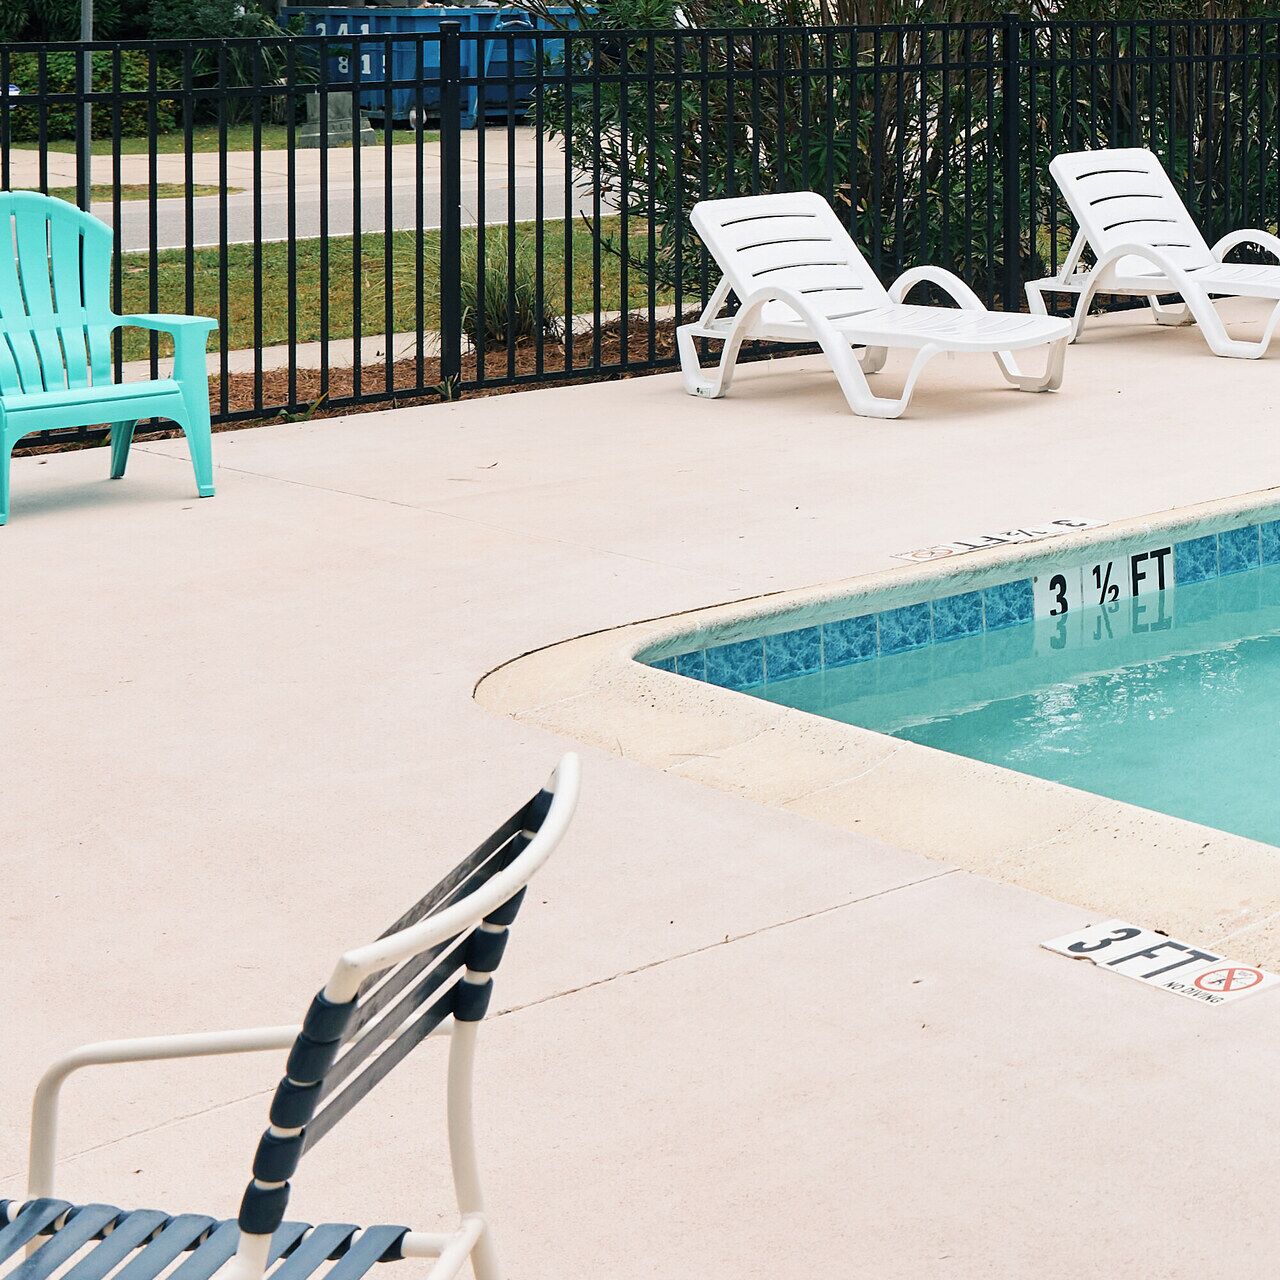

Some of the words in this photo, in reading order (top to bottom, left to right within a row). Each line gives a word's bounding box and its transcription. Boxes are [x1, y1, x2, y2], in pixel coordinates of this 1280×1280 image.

[1049, 574, 1069, 616] 3
[1131, 547, 1171, 598] FT
[1068, 928, 1142, 953] 3
[1107, 941, 1220, 979] FT
[1163, 981, 1185, 991] NO
[1181, 986, 1224, 1004] DIVING
